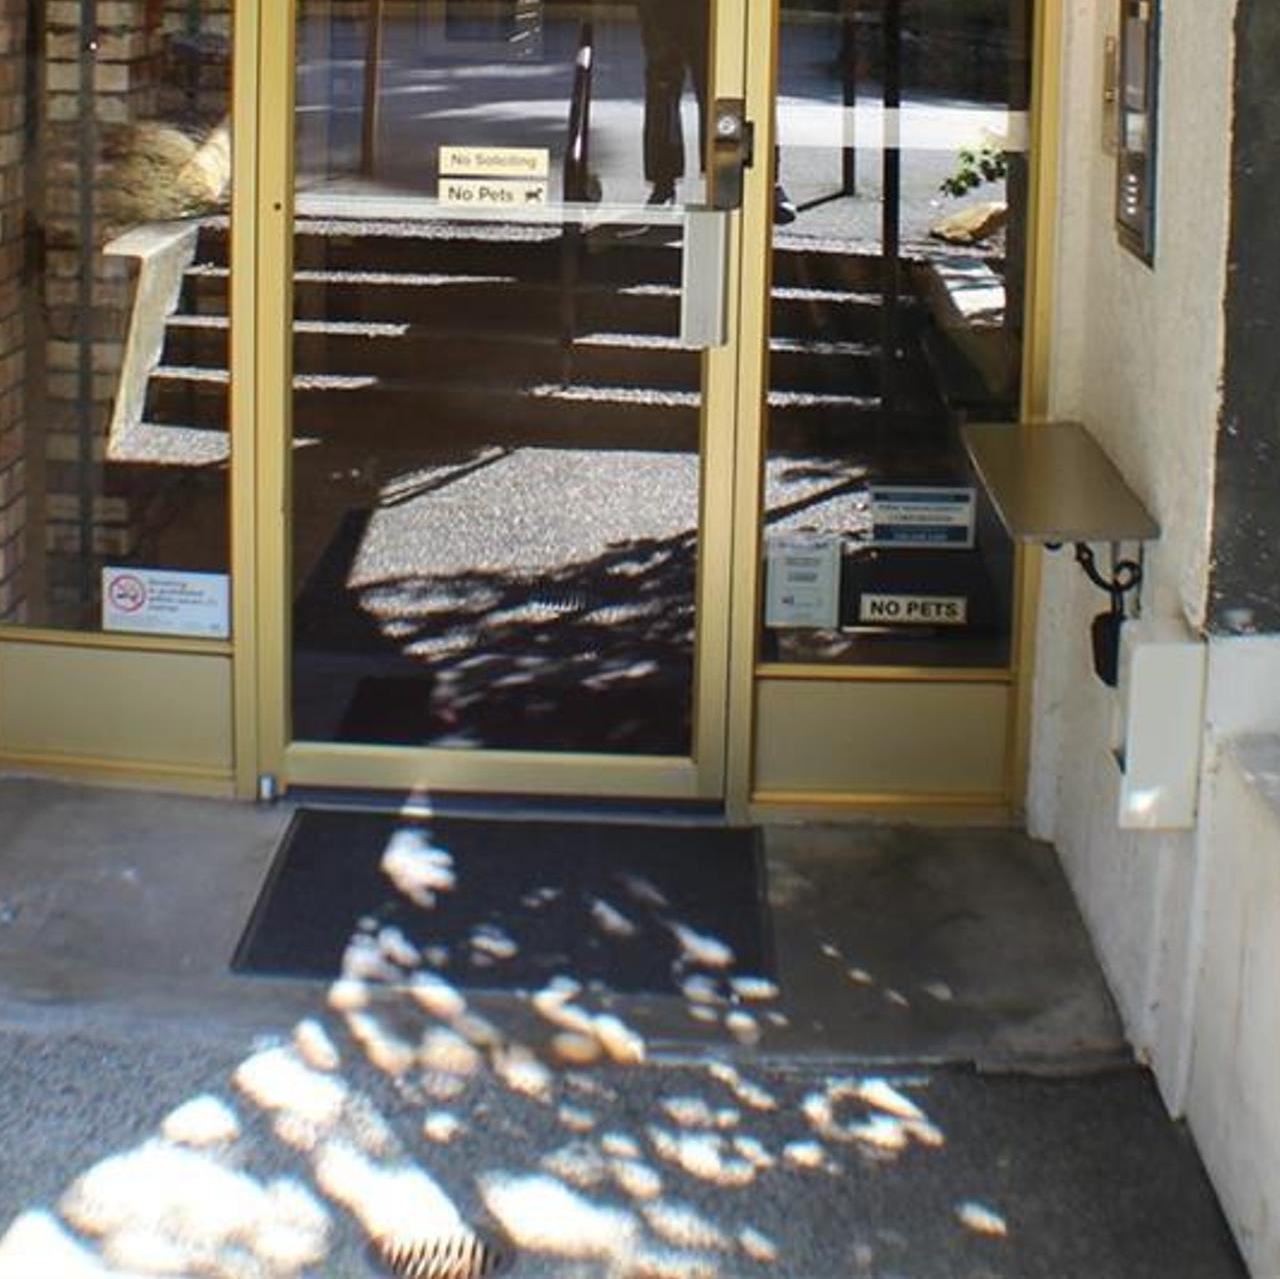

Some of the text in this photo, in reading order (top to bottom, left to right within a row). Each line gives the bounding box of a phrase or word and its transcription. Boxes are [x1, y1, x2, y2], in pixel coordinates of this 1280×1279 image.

[451, 154, 471, 166] No
[448, 186, 514, 201] No Pets
[870, 600, 958, 617] NO PETS
